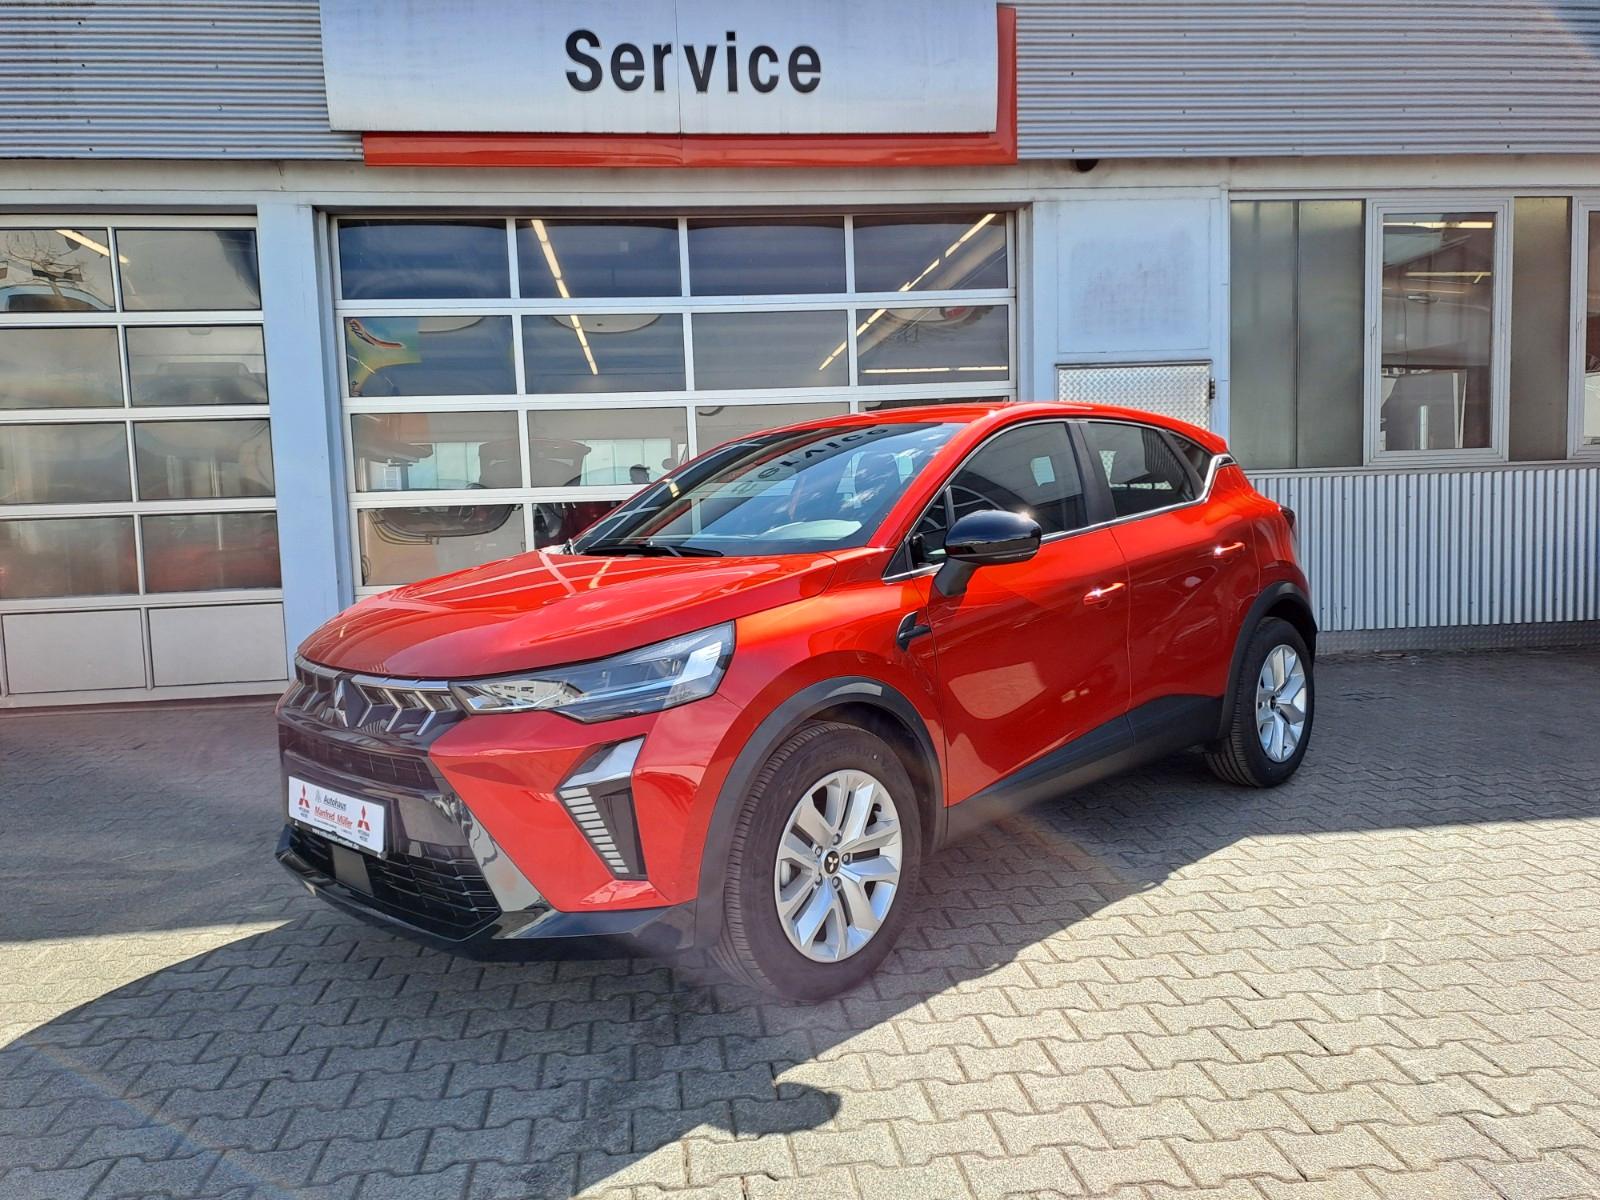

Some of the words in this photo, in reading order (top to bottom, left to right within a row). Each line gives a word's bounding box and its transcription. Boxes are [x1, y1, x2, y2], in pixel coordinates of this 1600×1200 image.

[565, 29, 821, 93] Service
[323, 795, 347, 811] Autohaus
[314, 806, 335, 821] Manfred
[337, 814, 353, 828] Müller
